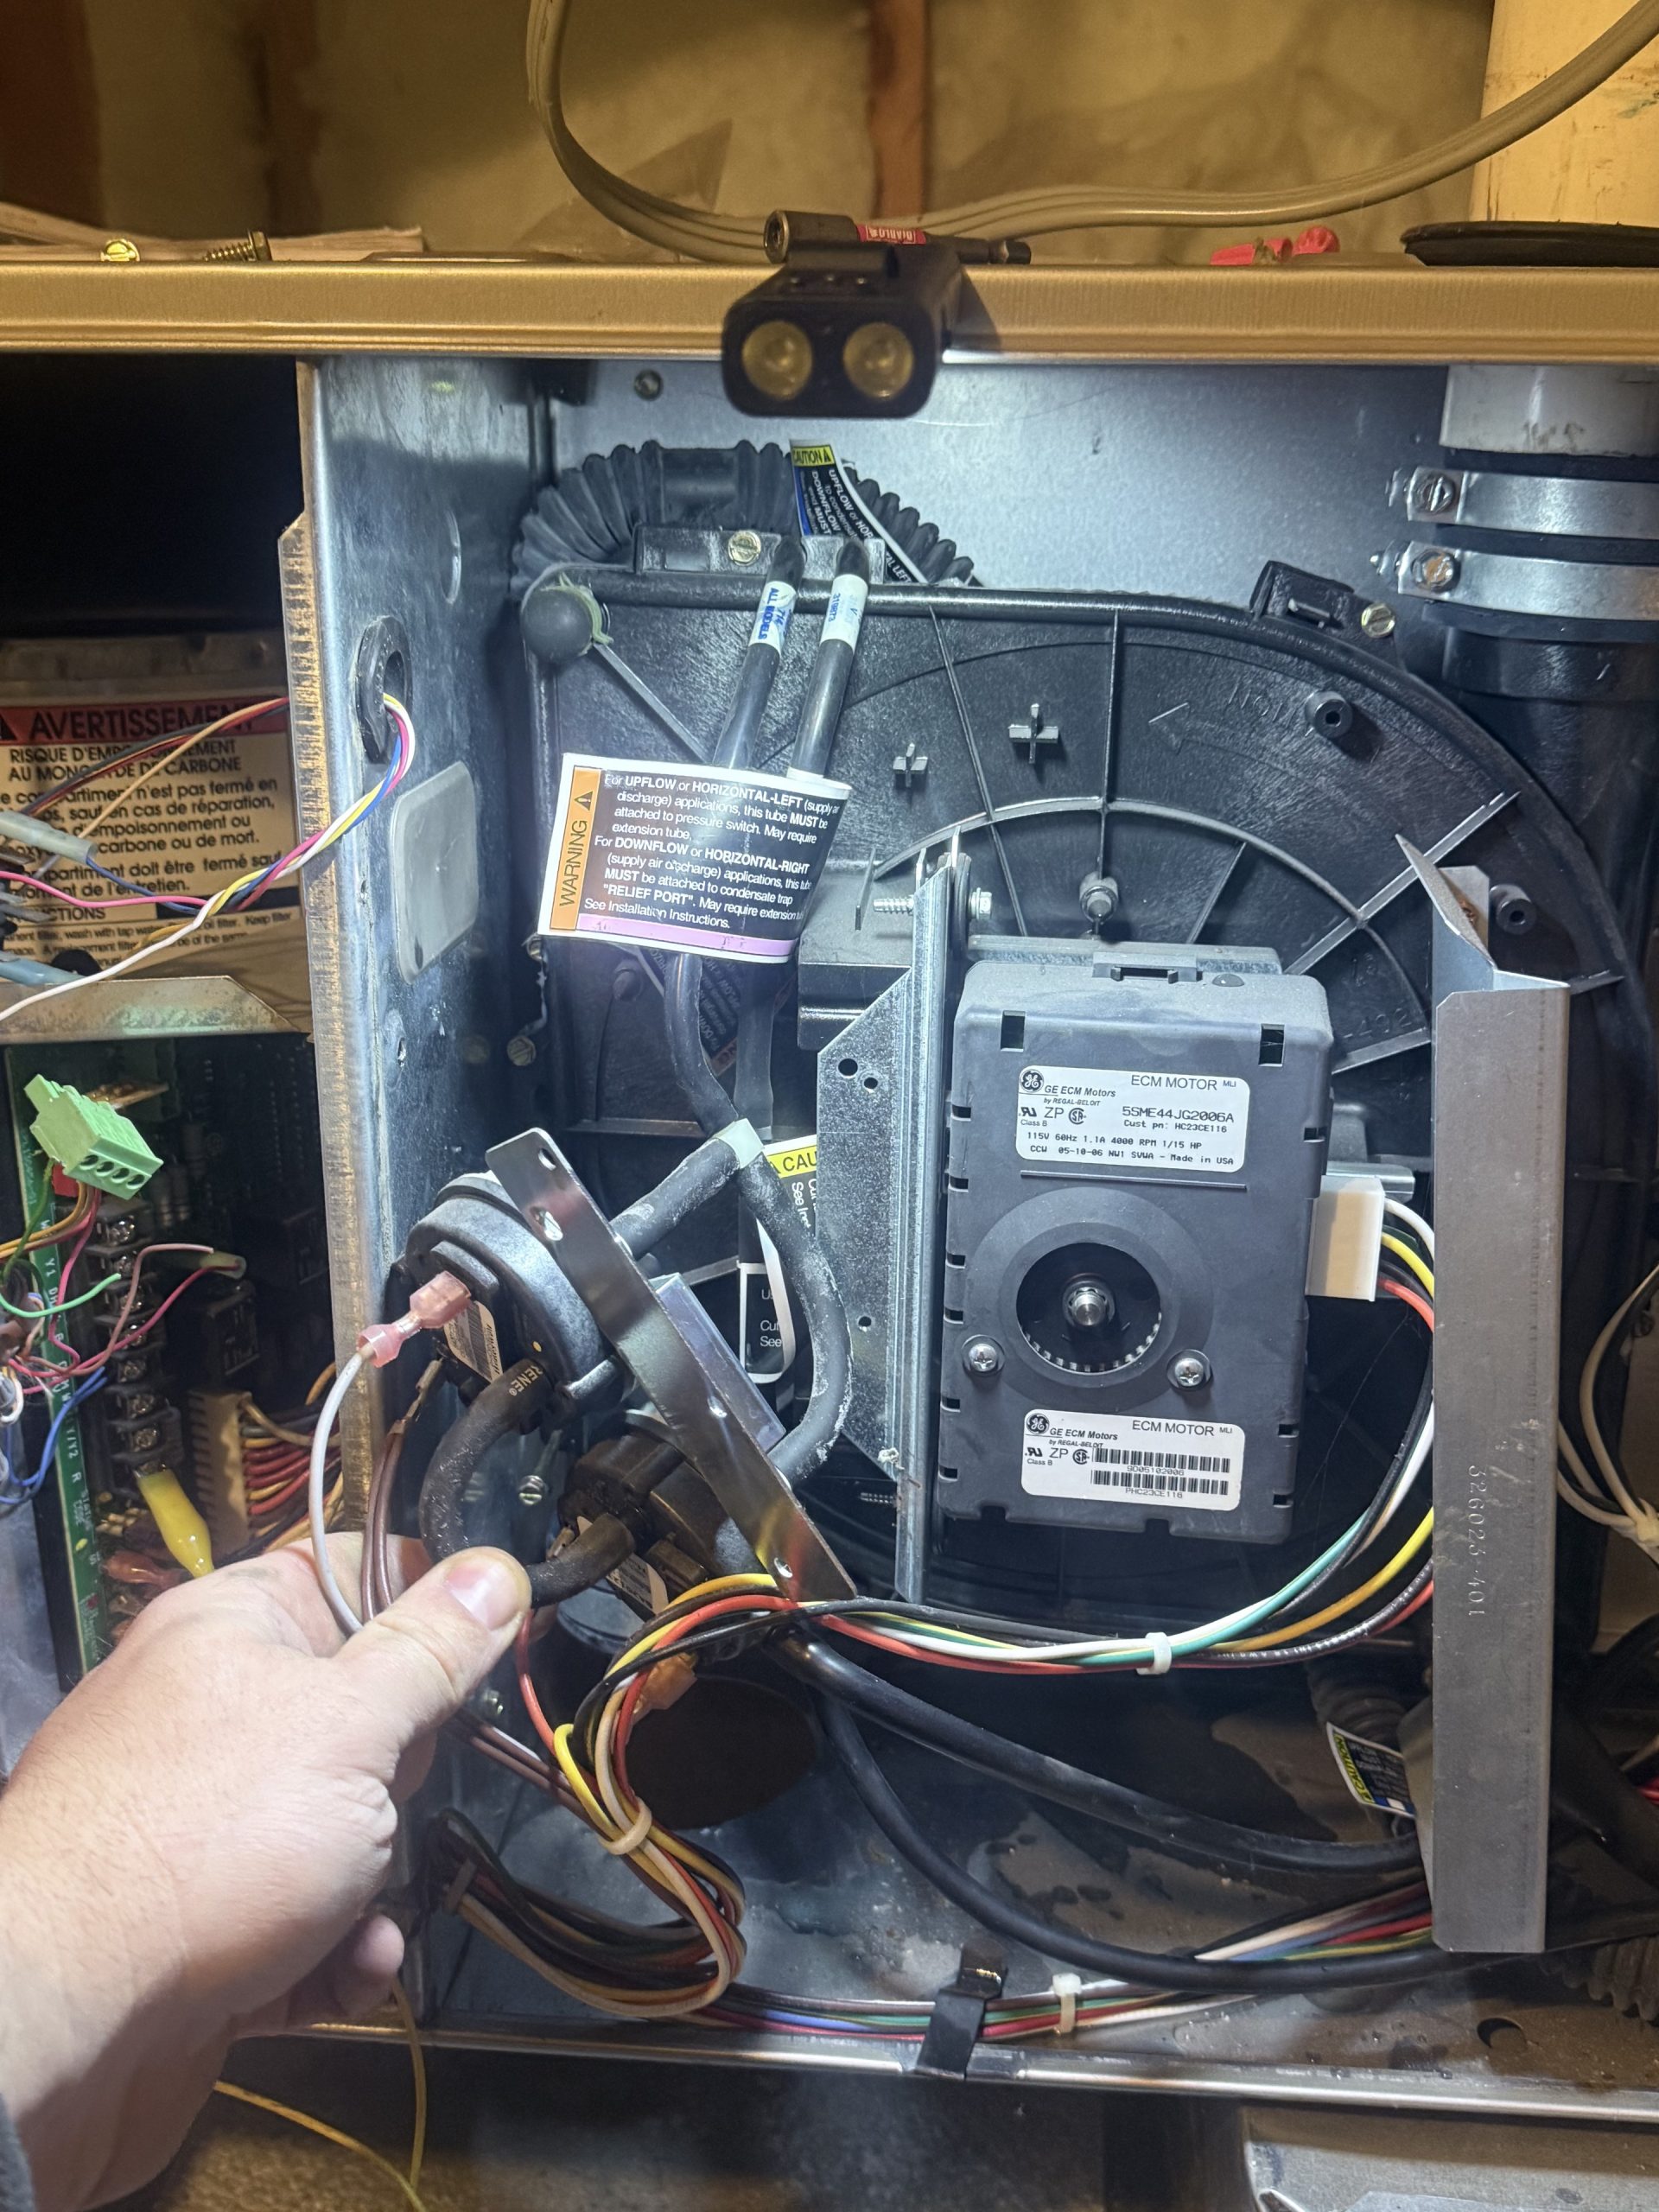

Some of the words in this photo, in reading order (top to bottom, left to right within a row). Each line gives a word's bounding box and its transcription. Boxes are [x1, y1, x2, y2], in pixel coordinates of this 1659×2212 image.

[829, 469, 855, 511] UPFLOW
[812, 471, 841, 531] DOWNFLOW
[814, 506, 831, 535] MUST
[766, 588, 779, 604] ALL
[10, 747, 67, 763] RISQUE
[9, 767, 31, 781] AU
[36, 762, 136, 780] MONODE
[164, 757, 241, 775] CARBONE
[137, 784, 172, 799] n'est
[177, 785, 206, 799] pas
[210, 777, 254, 795] fermé
[258, 779, 276, 790] en
[605, 773, 623, 786] For
[625, 776, 677, 790] UPFLOW
[678, 782, 690, 791] or
[692, 781, 803, 808] HORIZONTAL-LEFT
[804, 799, 832, 816] (supply
[70, 806, 103, 820] sauf
[110, 808, 129, 818] en
[133, 804, 162, 817] cas
[167, 802, 188, 815] de
[192, 796, 274, 816] réparation,
[617, 791, 672, 808] discharge)
[674, 796, 741, 816] applications,
[744, 804, 763, 818] this
[765, 810, 788, 823] tube
[790, 812, 819, 827] MUST
[818, 819, 829, 830] be
[73, 816, 226, 838] d'empoisonnement
[232, 816, 250, 828] ou
[612, 823, 663, 836] extension
[614, 807, 660, 821] attached
[662, 810, 674, 821] to
[676, 812, 723, 829] pressure
[726, 819, 761, 835] switch.
[764, 824, 786, 841] May
[787, 830, 817, 845] require
[99, 838, 166, 854] carbone
[171, 840, 192, 849] ou
[195, 834, 216, 848] de
[221, 830, 259, 846] mort.
[130, 861, 158, 876] doit
[164, 860, 194, 875] être
[203, 853, 248, 872] fermé
[559, 820, 588, 906] WARNING
[594, 836, 613, 847] For
[614, 836, 689, 855] DOWNFLOW
[690, 848, 705, 857] or
[705, 849, 810, 874] HORIZONTAL-RIGHT
[607, 852, 646, 868] (supply
[648, 857, 663, 868] air
[724, 869, 783, 889] applications,
[785, 877, 799, 889] this
[82, 885, 103, 897] de
[109, 878, 190, 896] l'etretien.
[605, 868, 639, 881] MUST
[642, 872, 655, 884] be
[658, 874, 706, 891] attached
[708, 882, 718, 893] to
[720, 886, 777, 902] condensate
[778, 893, 793, 907] trap
[604, 883, 651, 900] "RELIEF
[653, 889, 696, 907] PORT".
[699, 896, 723, 912] May
[724, 902, 758, 918] require
[760, 907, 796, 921] extension
[584, 898, 607, 911] See
[608, 900, 666, 918] Installation
[669, 908, 731, 928] Instructions.
[95, 925, 115, 936] with
[1045, 1085, 1058, 1094] GE
[1060, 1086, 1082, 1095] ECM
[1084, 1087, 1116, 1097] Motors
[1131, 1075, 1161, 1087] ECM
[1166, 1077, 1217, 1090] MOTOR
[1052, 1097, 1101, 1106] REGAL-BELOIT
[1044, 1106, 1064, 1119] ZP
[1122, 1106, 1235, 1122] 5SME44JG2006A
[1124, 1119, 1147, 1128] Cust
[1175, 1122, 1227, 1133] HC23CE116
[1139, 1138, 1157, 1147] RPM
[1058, 1147, 1103, 1156] 05-10-06
[1170, 1154, 1193, 1162] Made
[791, 1182, 804, 1205] See
[45, 1257, 56, 1277] Y1
[760, 1336, 782, 1347] See
[1050, 1427, 1063, 1436] GE
[1065, 1428, 1085, 1438] ECM
[1087, 1430, 1118, 1440] Motors
[1132, 1420, 1162, 1432] ECM
[1165, 1422, 1215, 1436] MOTOR
[67, 1428, 79, 1459] Y/Y2
[1049, 1447, 1069, 1459] ZP
[1057, 1440, 1103, 1448] REGAL-BELOIT
[72, 1471, 82, 1484] R
